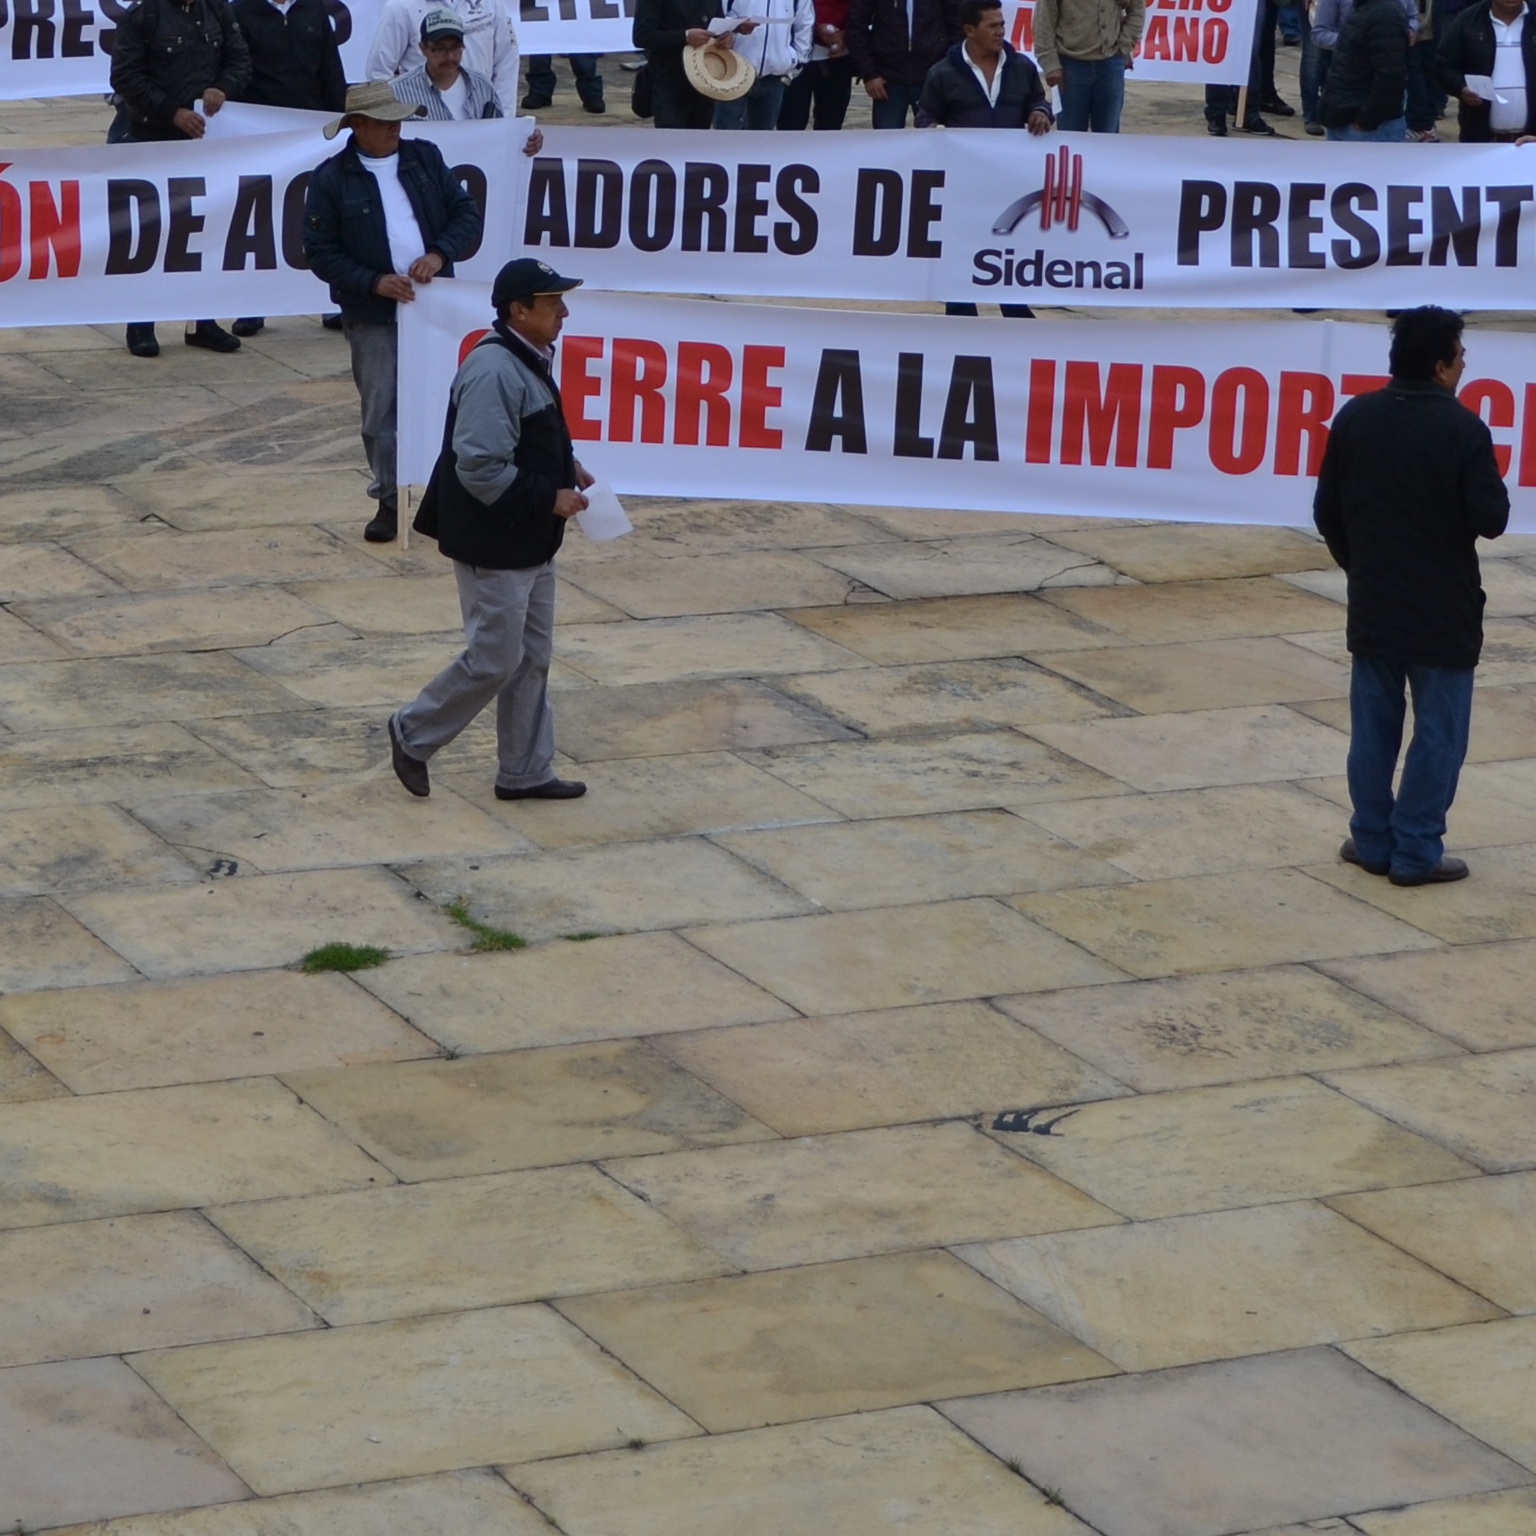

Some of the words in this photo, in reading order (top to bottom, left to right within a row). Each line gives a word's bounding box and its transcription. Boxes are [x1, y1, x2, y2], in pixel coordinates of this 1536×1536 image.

[104, 177, 207, 275] DE
[524, 157, 821, 256] ADORES
[853, 168, 946, 259] DE
[971, 249, 1144, 290] Sidenal
[458, 328, 786, 450] ERRE
[805, 348, 867, 455] A
[892, 352, 1000, 463] LA
